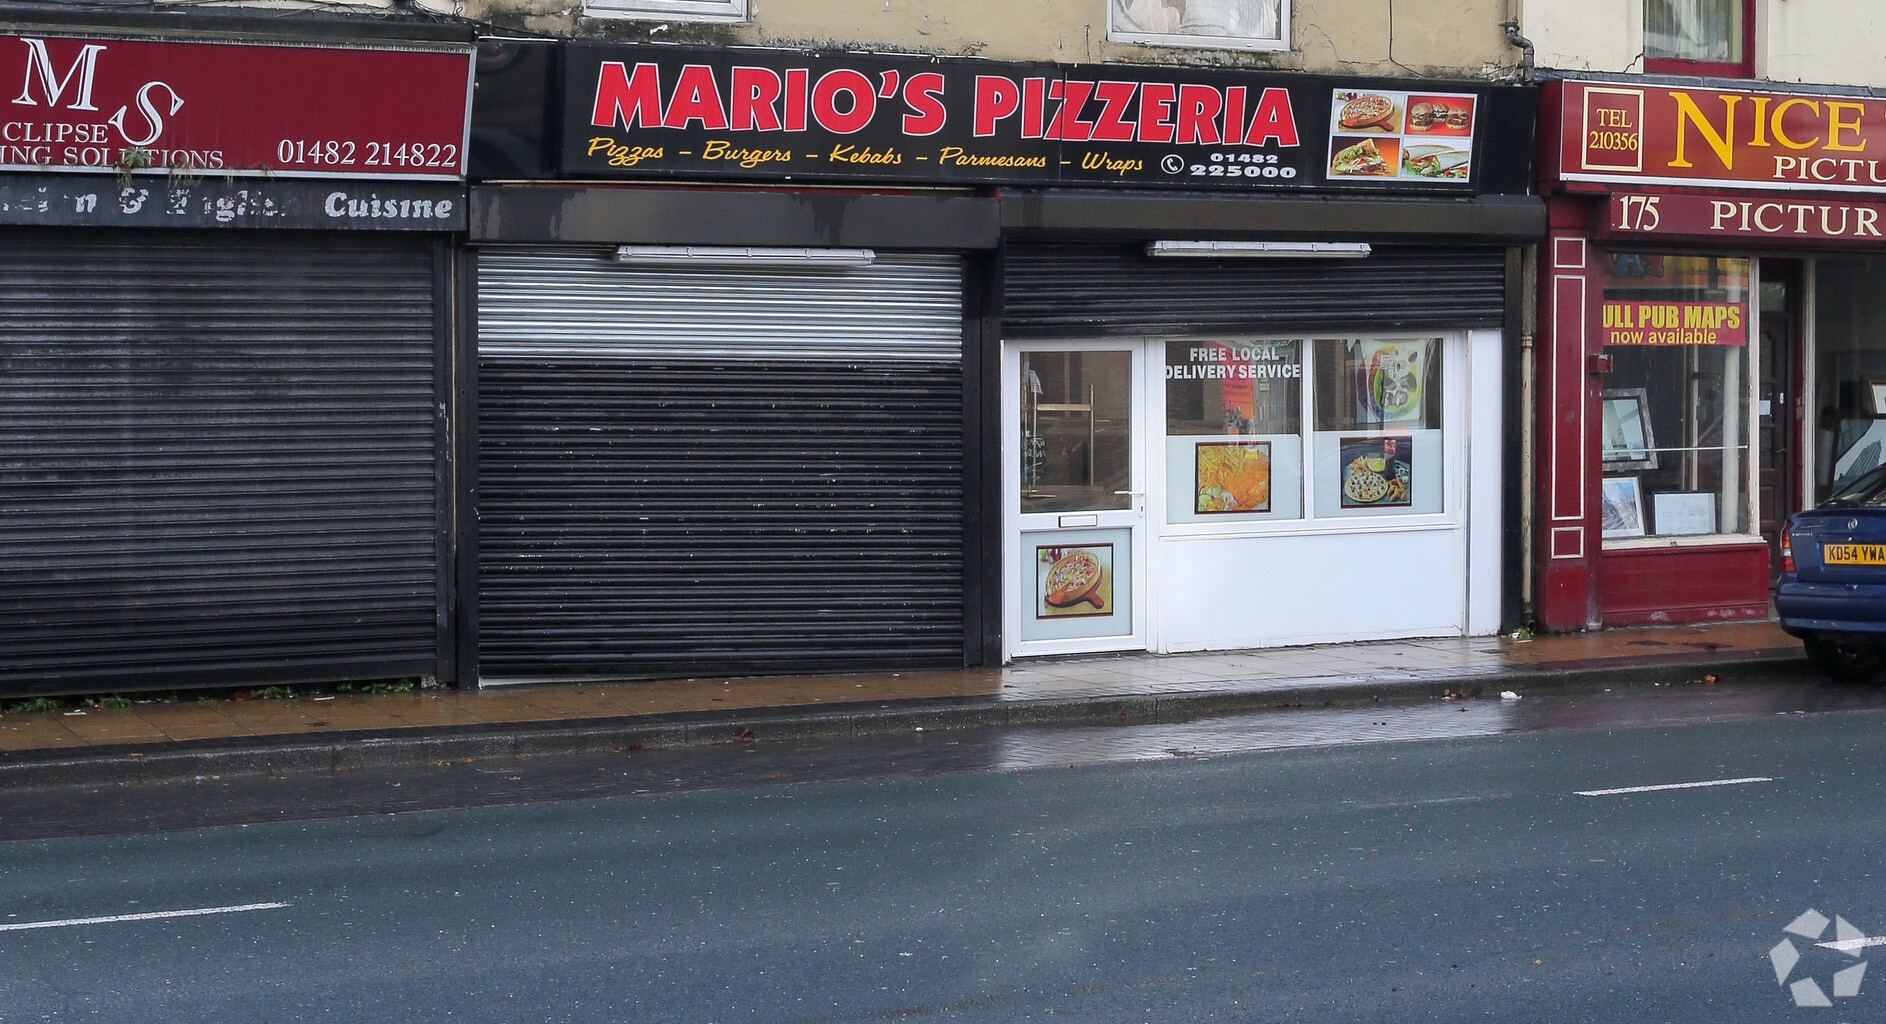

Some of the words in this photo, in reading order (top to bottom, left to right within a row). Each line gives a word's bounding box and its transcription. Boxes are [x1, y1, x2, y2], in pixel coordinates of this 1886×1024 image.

[12, 38, 107, 111] M
[108, 81, 184, 146] S
[591, 61, 947, 136] MARIO'S
[973, 74, 1300, 148] PIZZERIA
[1596, 108, 1633, 128] TEL
[3, 122, 108, 143] CLIPSE
[1589, 130, 1638, 151] 210356
[1667, 91, 1867, 170] NICE
[277, 139, 355, 165] 01482
[365, 141, 456, 167] 214822
[588, 136, 663, 166] Pizzas
[703, 140, 791, 168] Burgers
[829, 144, 903, 165] Kebabs
[939, 146, 1046, 168] Parmesans
[1082, 151, 1143, 176] Wraps
[1210, 153, 1278, 164] 01482
[1190, 164, 1296, 178] 225000
[1773, 155, 1886, 184] PICTU
[325, 191, 453, 219] Cuisine
[1619, 195, 1660, 231] 175
[1710, 200, 1882, 238] PICTUR
[1603, 304, 1634, 328] ULL
[1638, 305, 1679, 328] PUB
[1684, 305, 1740, 329] MAPS
[1610, 331, 1643, 344] now
[1648, 328, 1717, 344] available
[1190, 347, 1227, 362] FREE
[1232, 347, 1279, 361] LOCAL
[1166, 365, 1236, 379] DELIVERY
[1238, 364, 1300, 379] SERVICE
[1829, 546, 1858, 561] KD54
[1861, 546, 1885, 561] YWA
